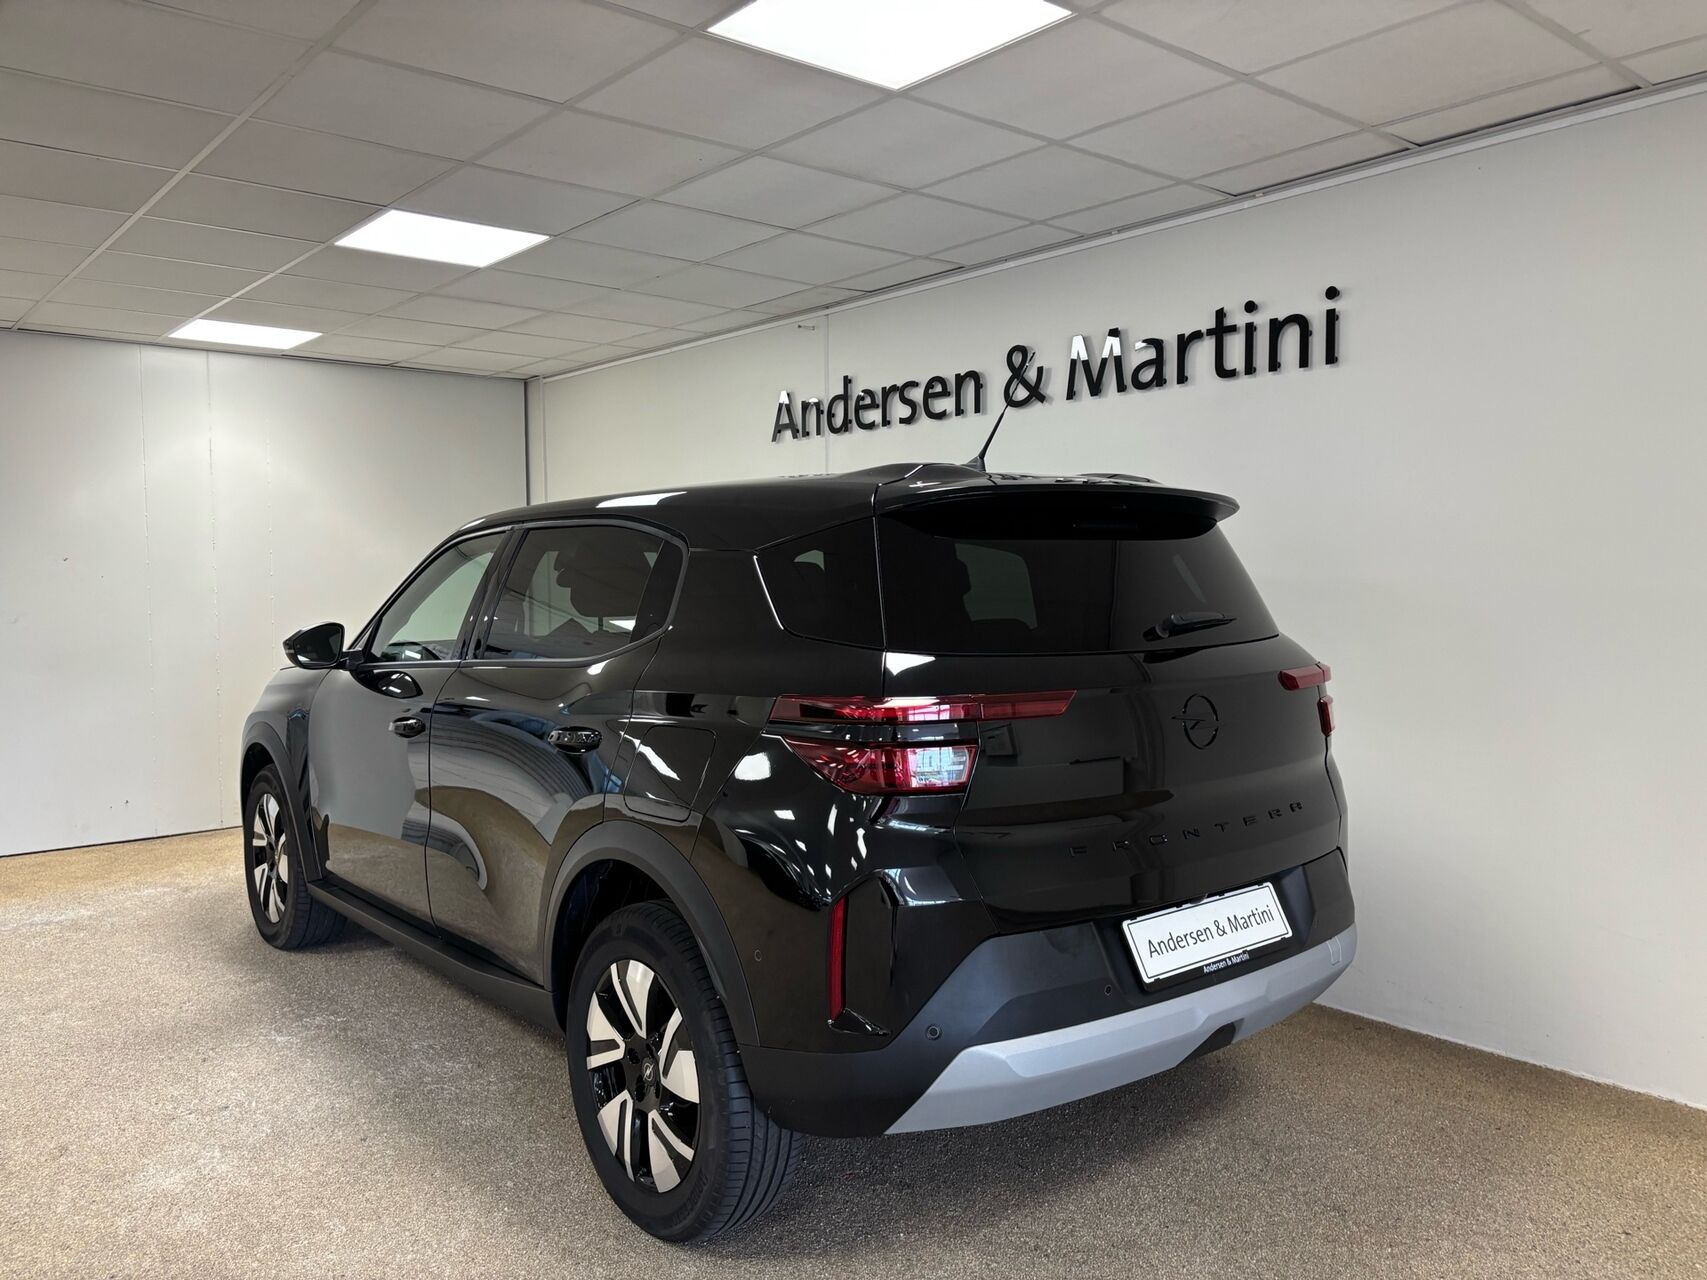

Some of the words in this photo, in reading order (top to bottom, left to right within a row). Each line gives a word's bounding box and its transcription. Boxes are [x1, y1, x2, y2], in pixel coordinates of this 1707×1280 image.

[771, 368, 985, 443] Andersen
[1003, 344, 1046, 409] &
[1065, 285, 1341, 402] Martini
[1069, 801, 1304, 857] FRONTERA
[1148, 926, 1214, 958] Andersen
[1213, 919, 1228, 937] &
[1227, 905, 1275, 934] Martini
[1203, 959, 1226, 974] Andersen
[1232, 951, 1249, 965] Martini
